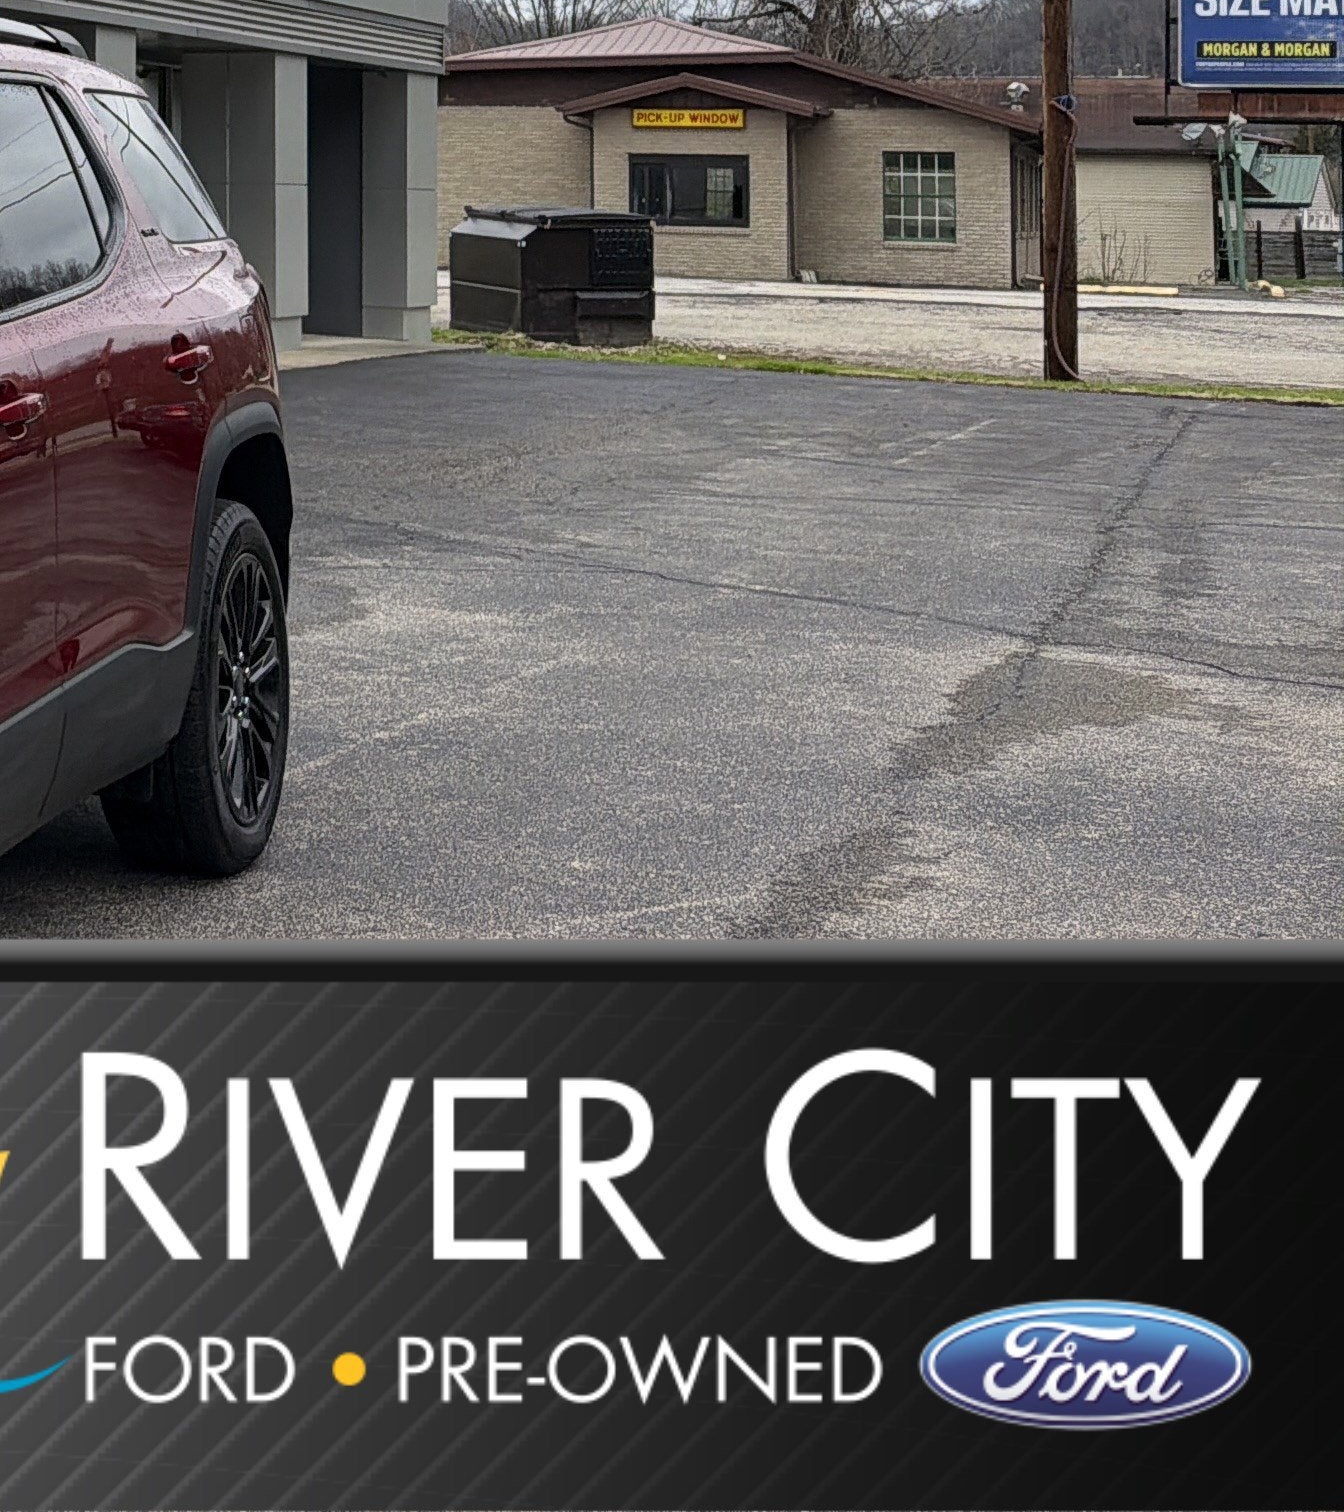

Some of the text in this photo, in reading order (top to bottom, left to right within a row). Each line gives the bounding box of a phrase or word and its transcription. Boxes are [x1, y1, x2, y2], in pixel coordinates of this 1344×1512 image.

[1202, 42, 1331, 57] MORGAN & MORGAN
[636, 112, 740, 124] PICK-UP WINDOW
